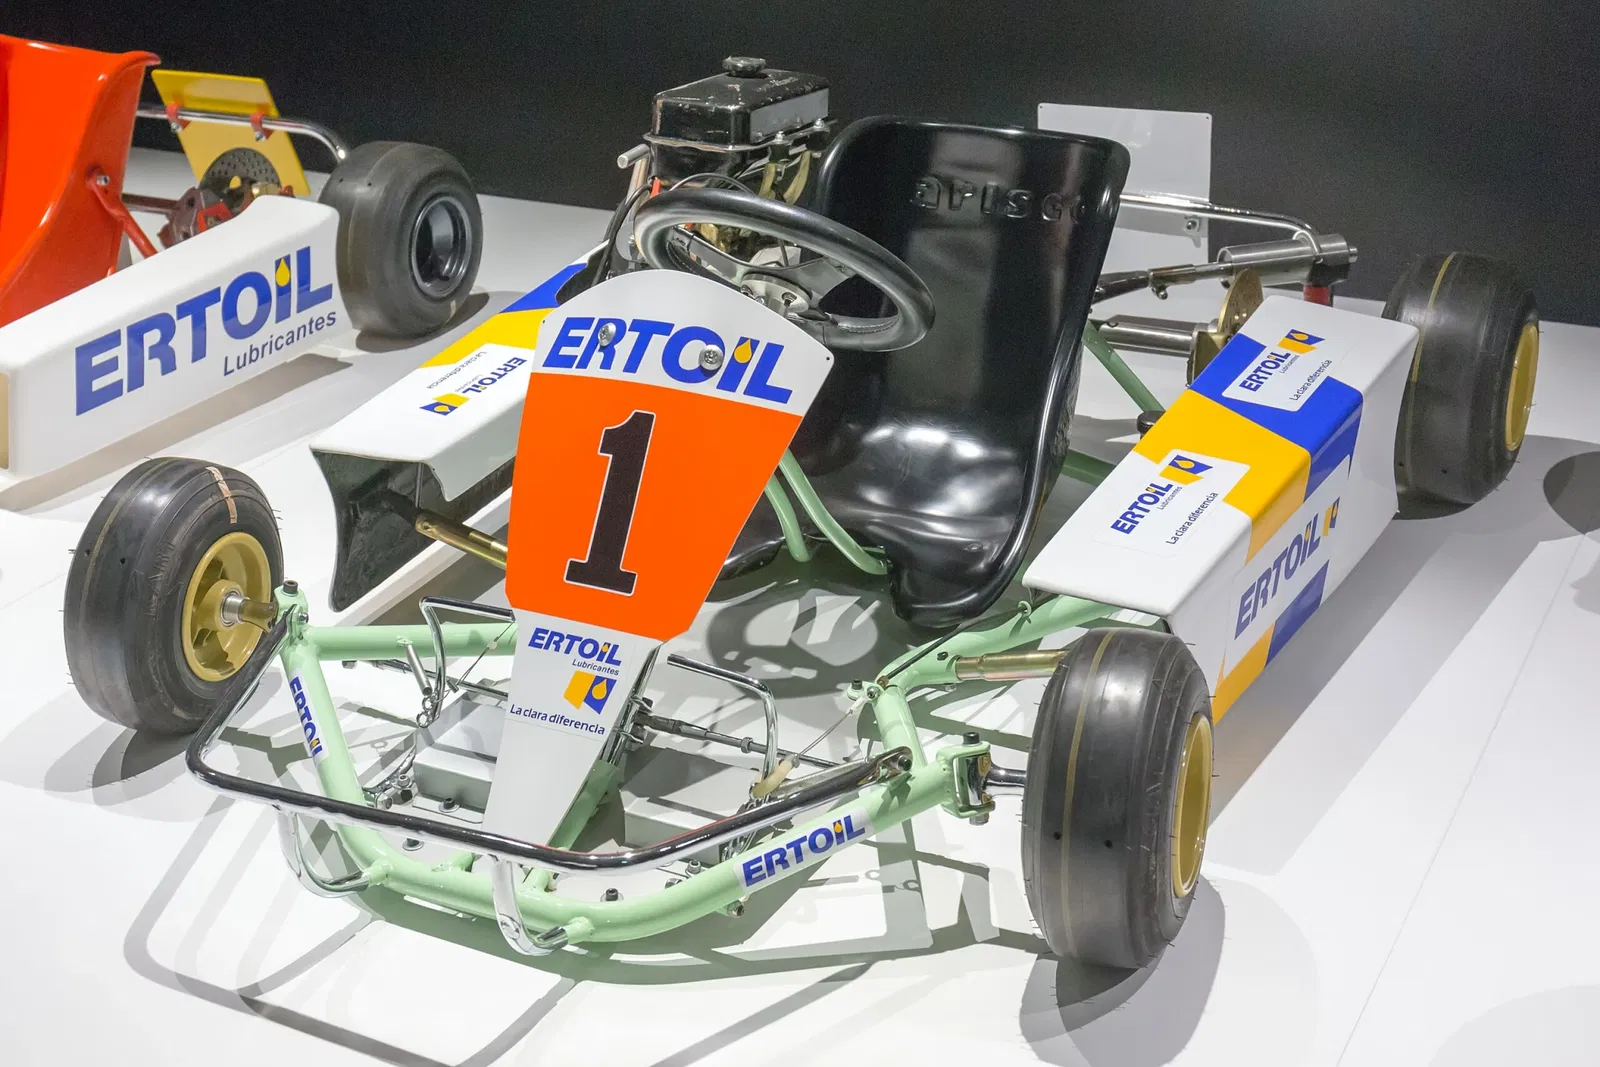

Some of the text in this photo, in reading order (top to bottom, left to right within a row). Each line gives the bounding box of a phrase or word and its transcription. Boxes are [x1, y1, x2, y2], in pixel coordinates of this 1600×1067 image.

[75, 246, 333, 416] ERTOIL
[223, 311, 337, 377] Lubricantes
[462, 357, 528, 394] ERTOIL
[542, 317, 793, 404] ERTOIL
[1239, 352, 1291, 392] ERTOIL
[563, 410, 656, 596] 1
[1110, 483, 1173, 535] ERTOIL
[1166, 492, 1219, 545] La clara diferencia
[1234, 512, 1321, 640] ERTOIL
[528, 627, 622, 666] ERTOIL
[572, 659, 620, 676] Lubricantes
[509, 704, 606, 735] La clara diferencia
[742, 815, 866, 887] ERTOIL
